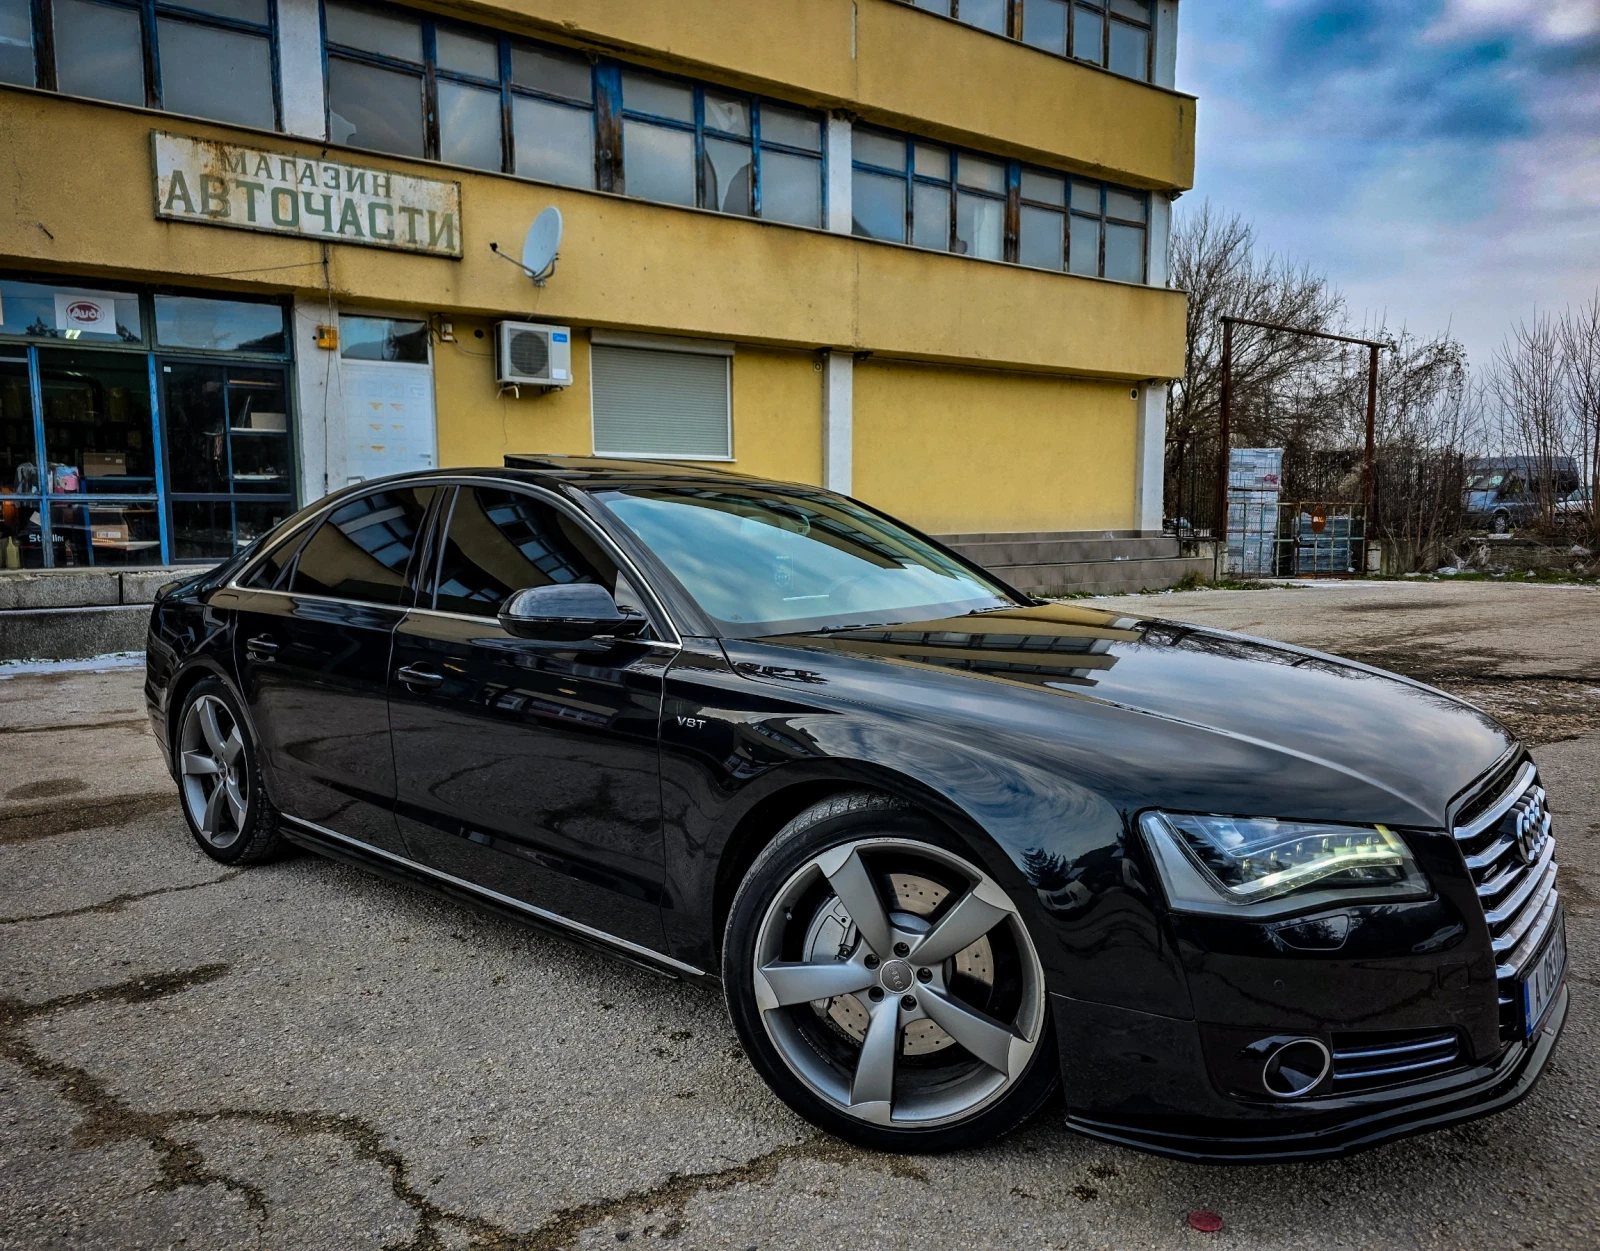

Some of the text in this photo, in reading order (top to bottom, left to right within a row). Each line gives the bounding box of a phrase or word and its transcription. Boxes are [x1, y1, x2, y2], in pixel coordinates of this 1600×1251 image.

[221, 150, 392, 198] МАГАЗИН
[163, 170, 455, 249] АВТОЧАСТИ
[677, 716, 706, 729] V8T
